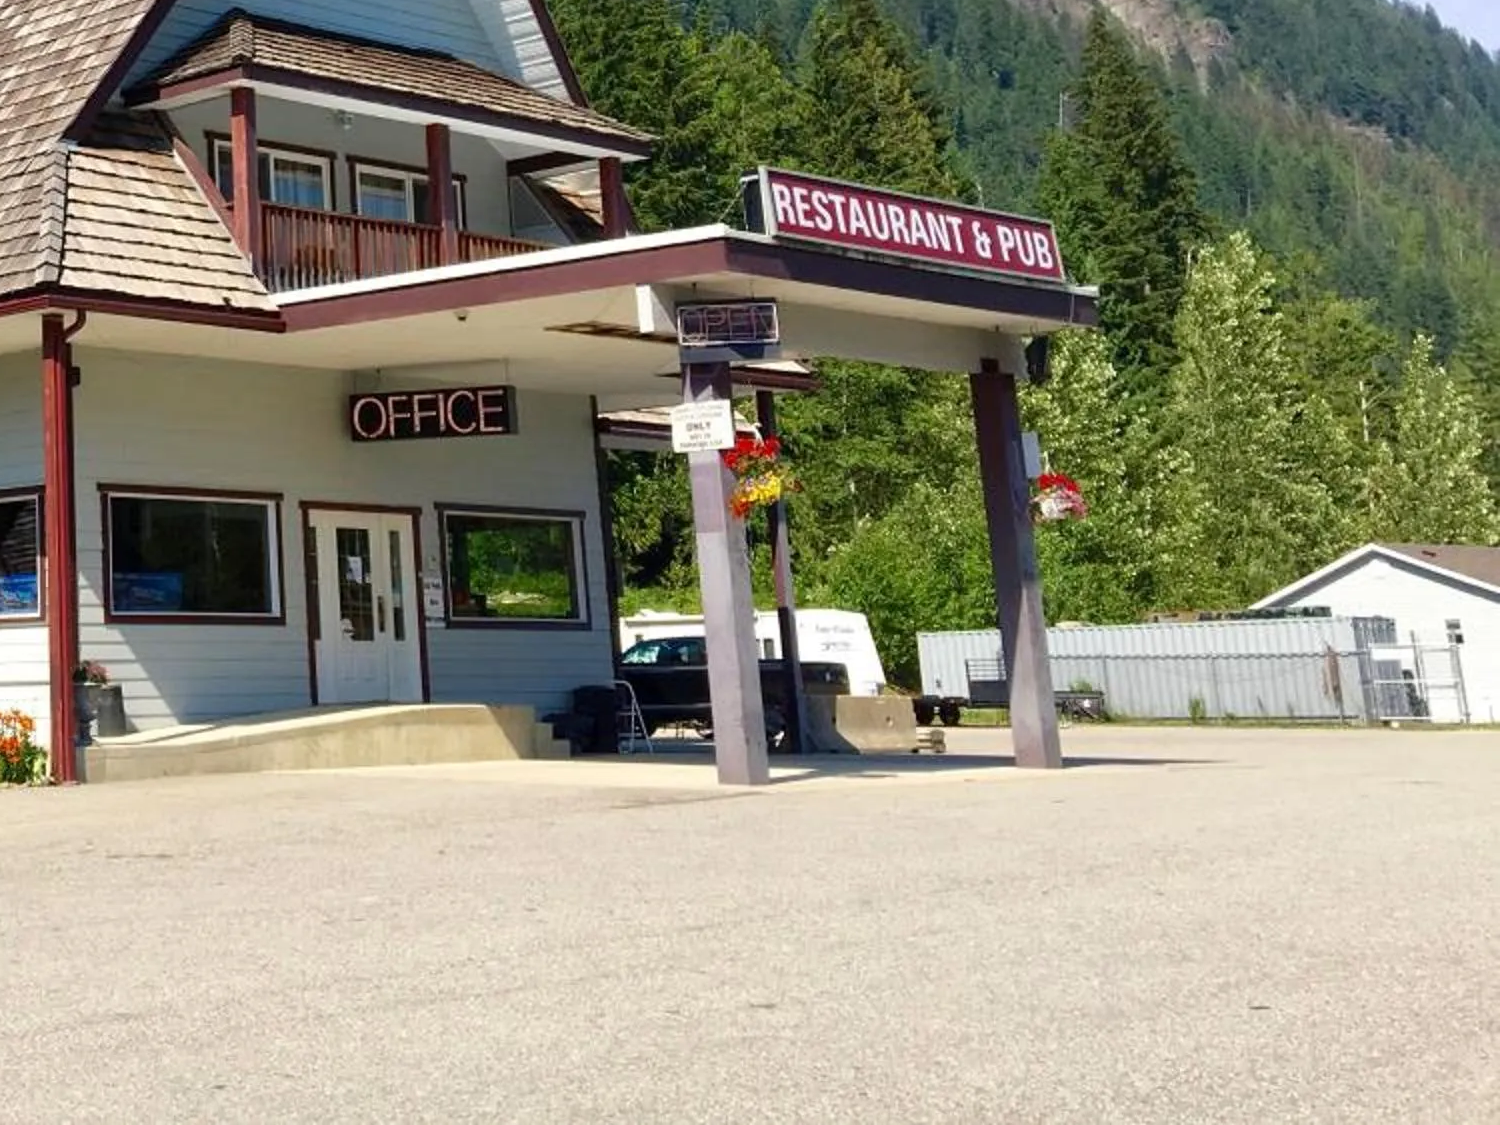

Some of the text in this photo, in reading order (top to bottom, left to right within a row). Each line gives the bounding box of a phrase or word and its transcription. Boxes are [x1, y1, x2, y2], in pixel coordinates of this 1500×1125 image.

[771, 182, 1054, 269] RESTAURANT & PUB
[681, 306, 775, 343] OPEN
[352, 389, 504, 439] OFFICE
